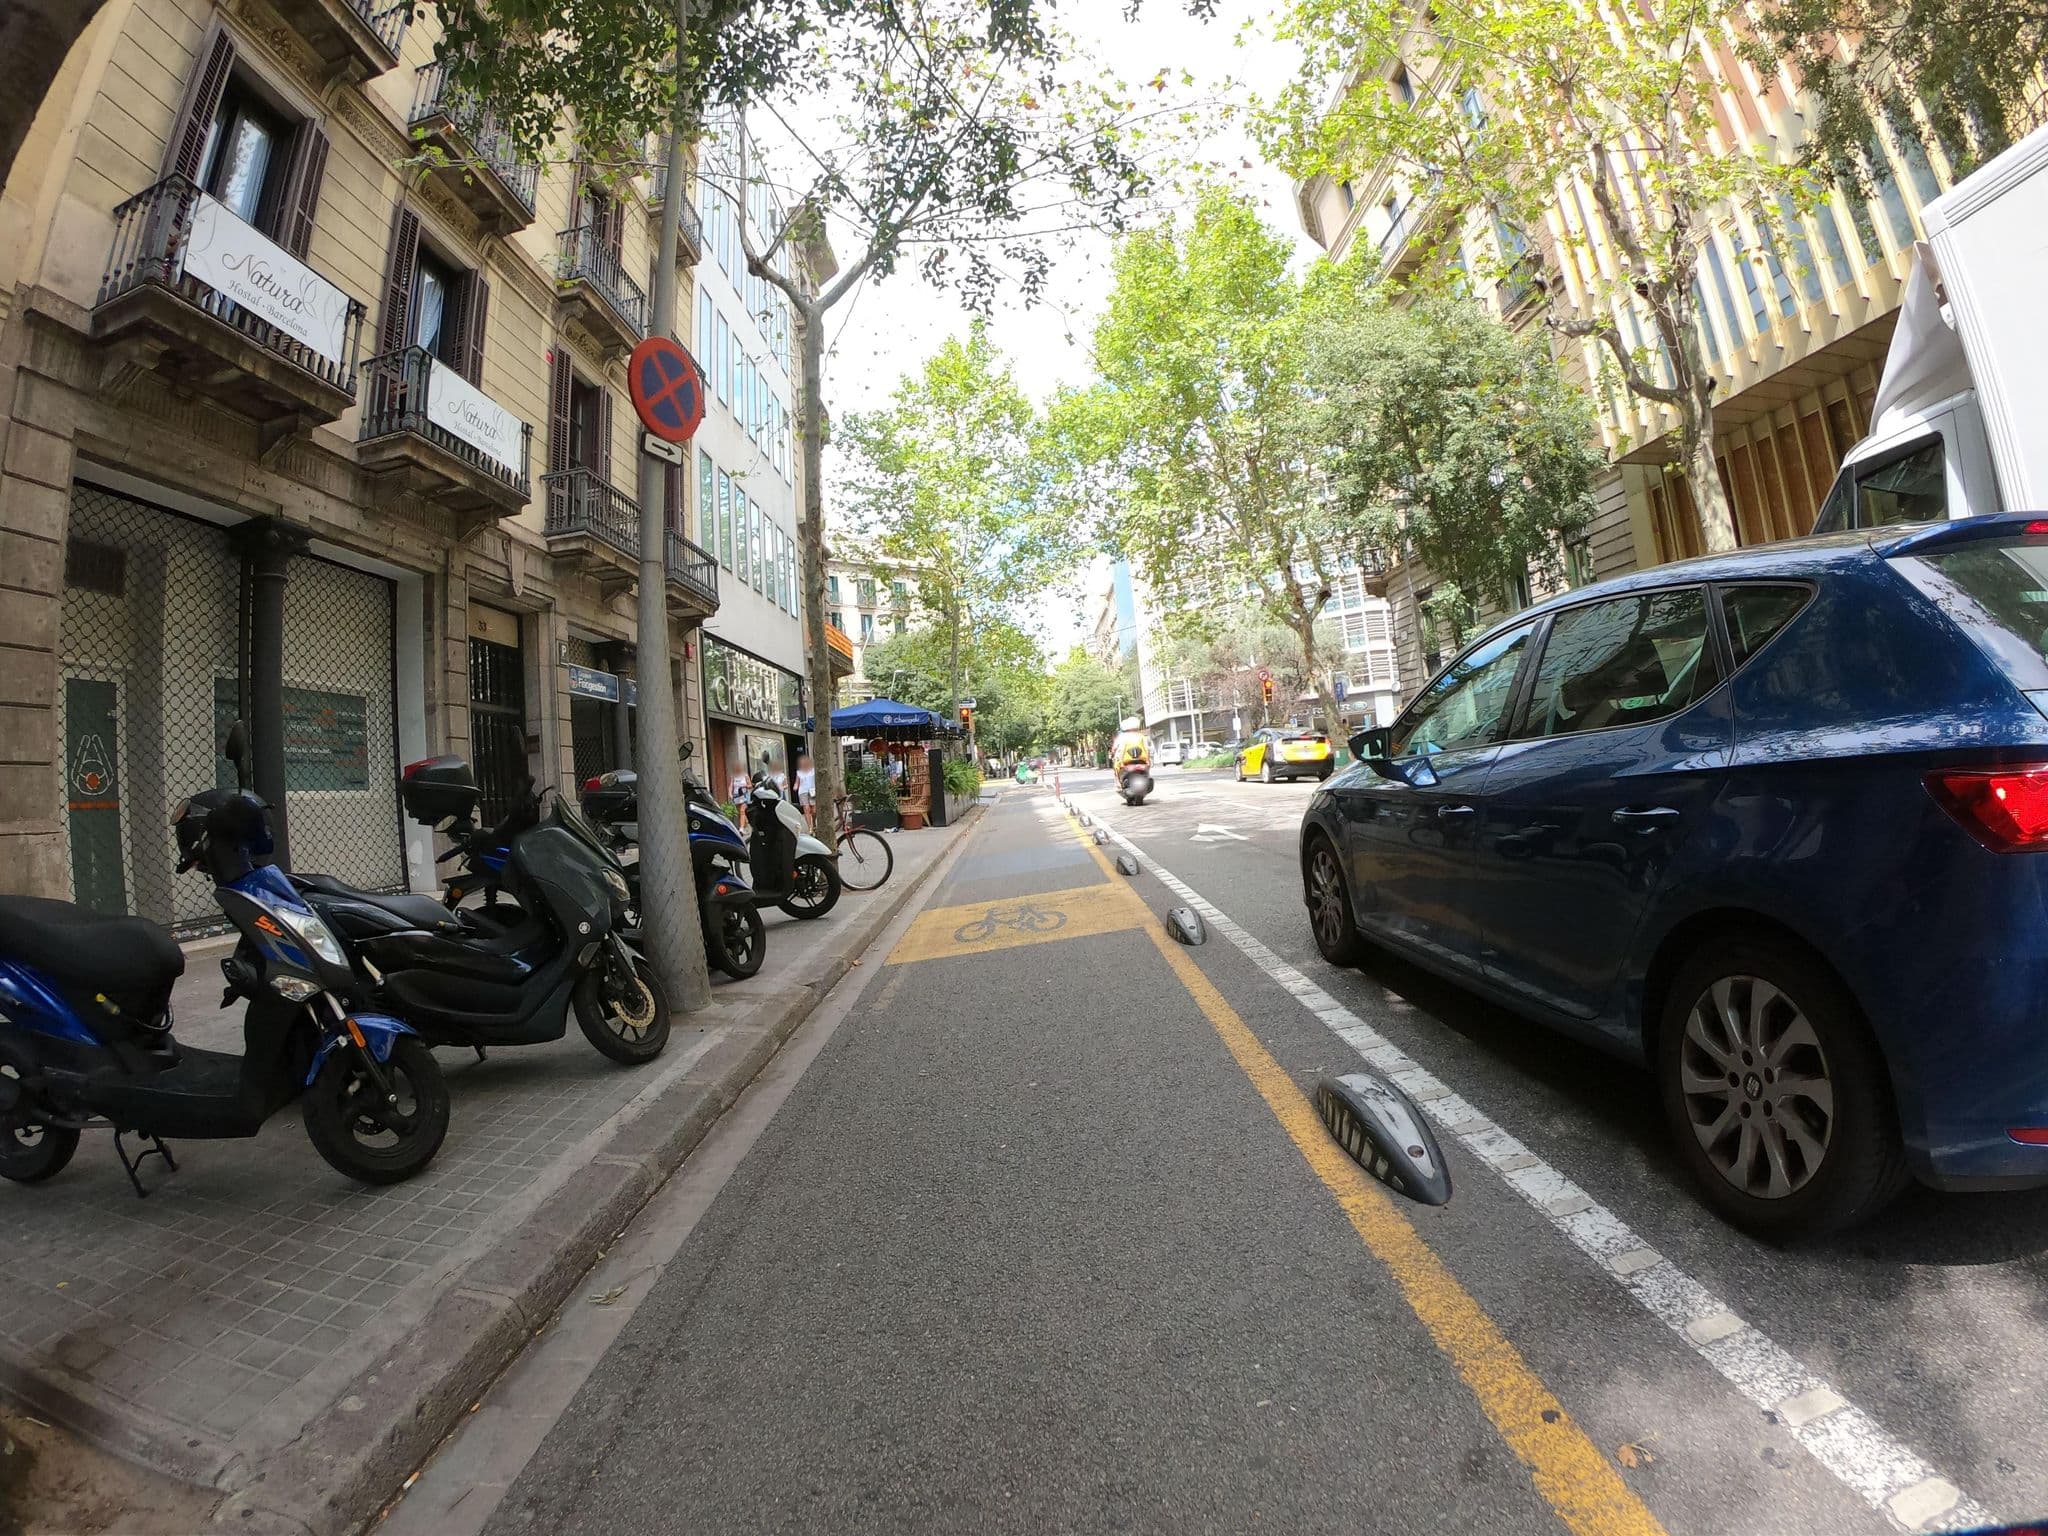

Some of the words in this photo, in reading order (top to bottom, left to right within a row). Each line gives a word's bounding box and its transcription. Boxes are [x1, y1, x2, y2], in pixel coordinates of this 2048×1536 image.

[222, 253, 303, 315] Natura
[228, 279, 263, 307] Hostal
[266, 304, 309, 337] Barcelona
[448, 399, 498, 440] Natura
